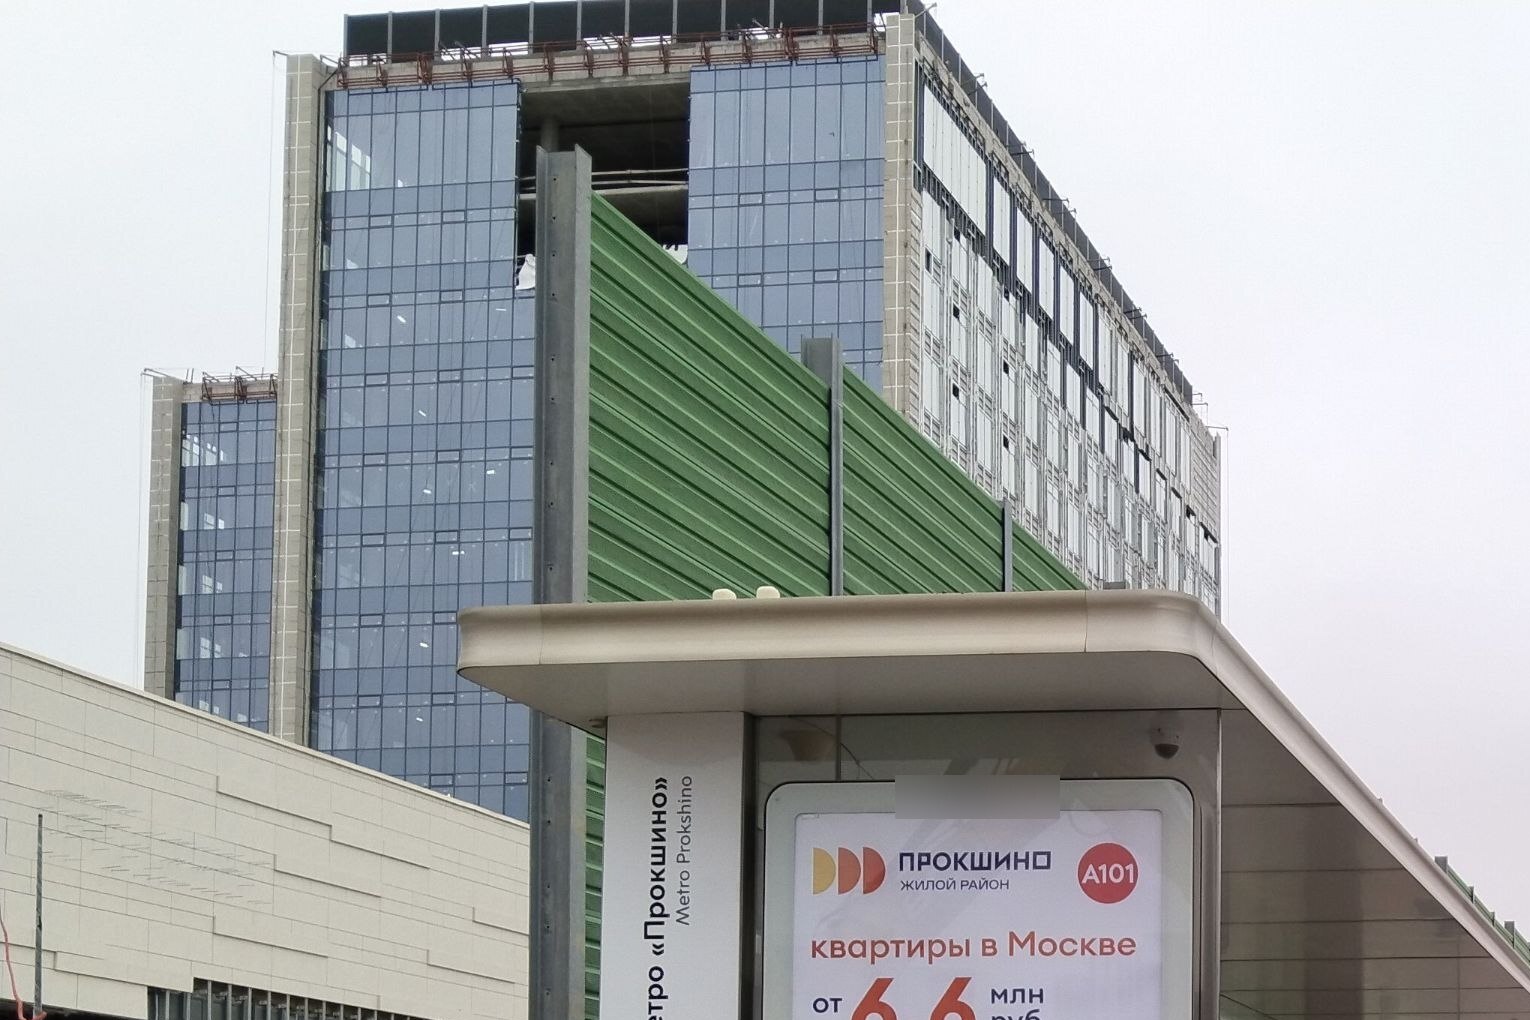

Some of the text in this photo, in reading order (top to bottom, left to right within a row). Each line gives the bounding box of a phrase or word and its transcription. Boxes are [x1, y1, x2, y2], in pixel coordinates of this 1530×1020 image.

[676, 775, 693, 927] Metro Prokshino
[899, 850, 1052, 872] ПРОКШИНО
[644, 776, 671, 957] «Прокшино»
[1081, 863, 1135, 885] А101
[900, 877, 1010, 892] ЖИЛОЙ РАЙОН
[811, 931, 1137, 965] квартиры в Москве
[812, 997, 843, 1014] от
[991, 988, 1044, 1005] млн
